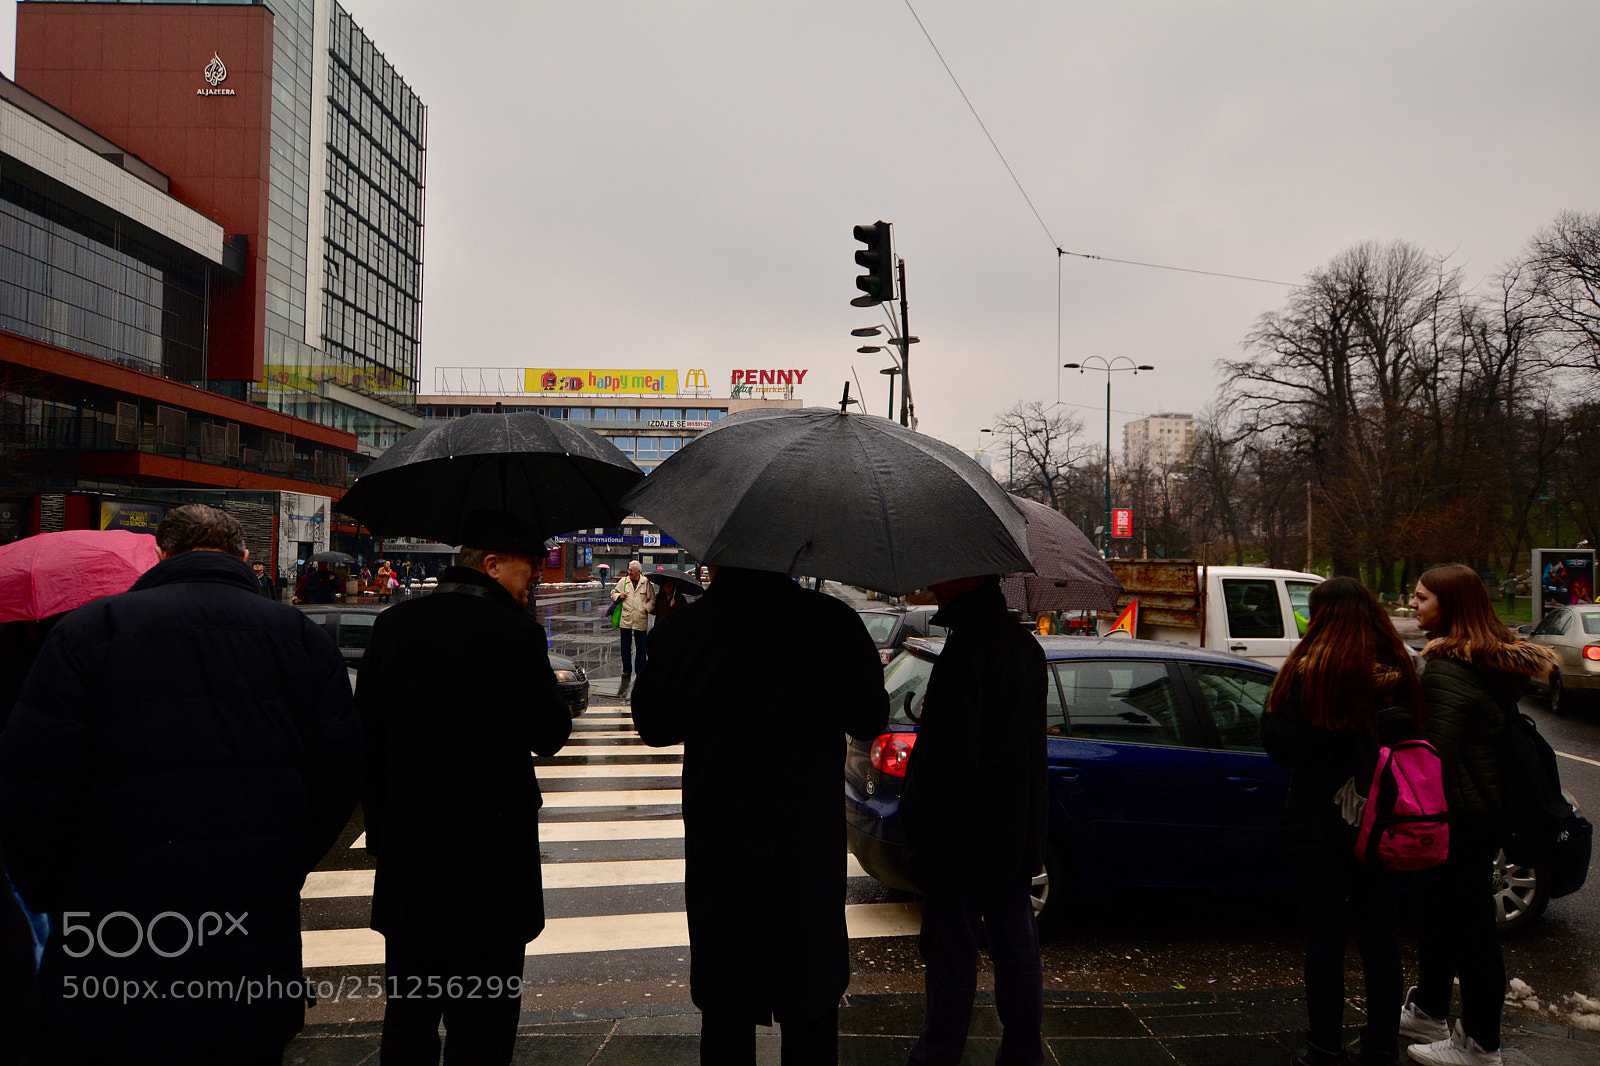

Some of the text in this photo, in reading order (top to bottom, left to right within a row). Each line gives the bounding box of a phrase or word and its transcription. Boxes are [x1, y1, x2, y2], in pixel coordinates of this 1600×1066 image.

[588, 371, 665, 392] happy meal
[731, 369, 809, 385] PENNY
[647, 420, 674, 428] IZDAJE
[676, 420, 686, 428] SE
